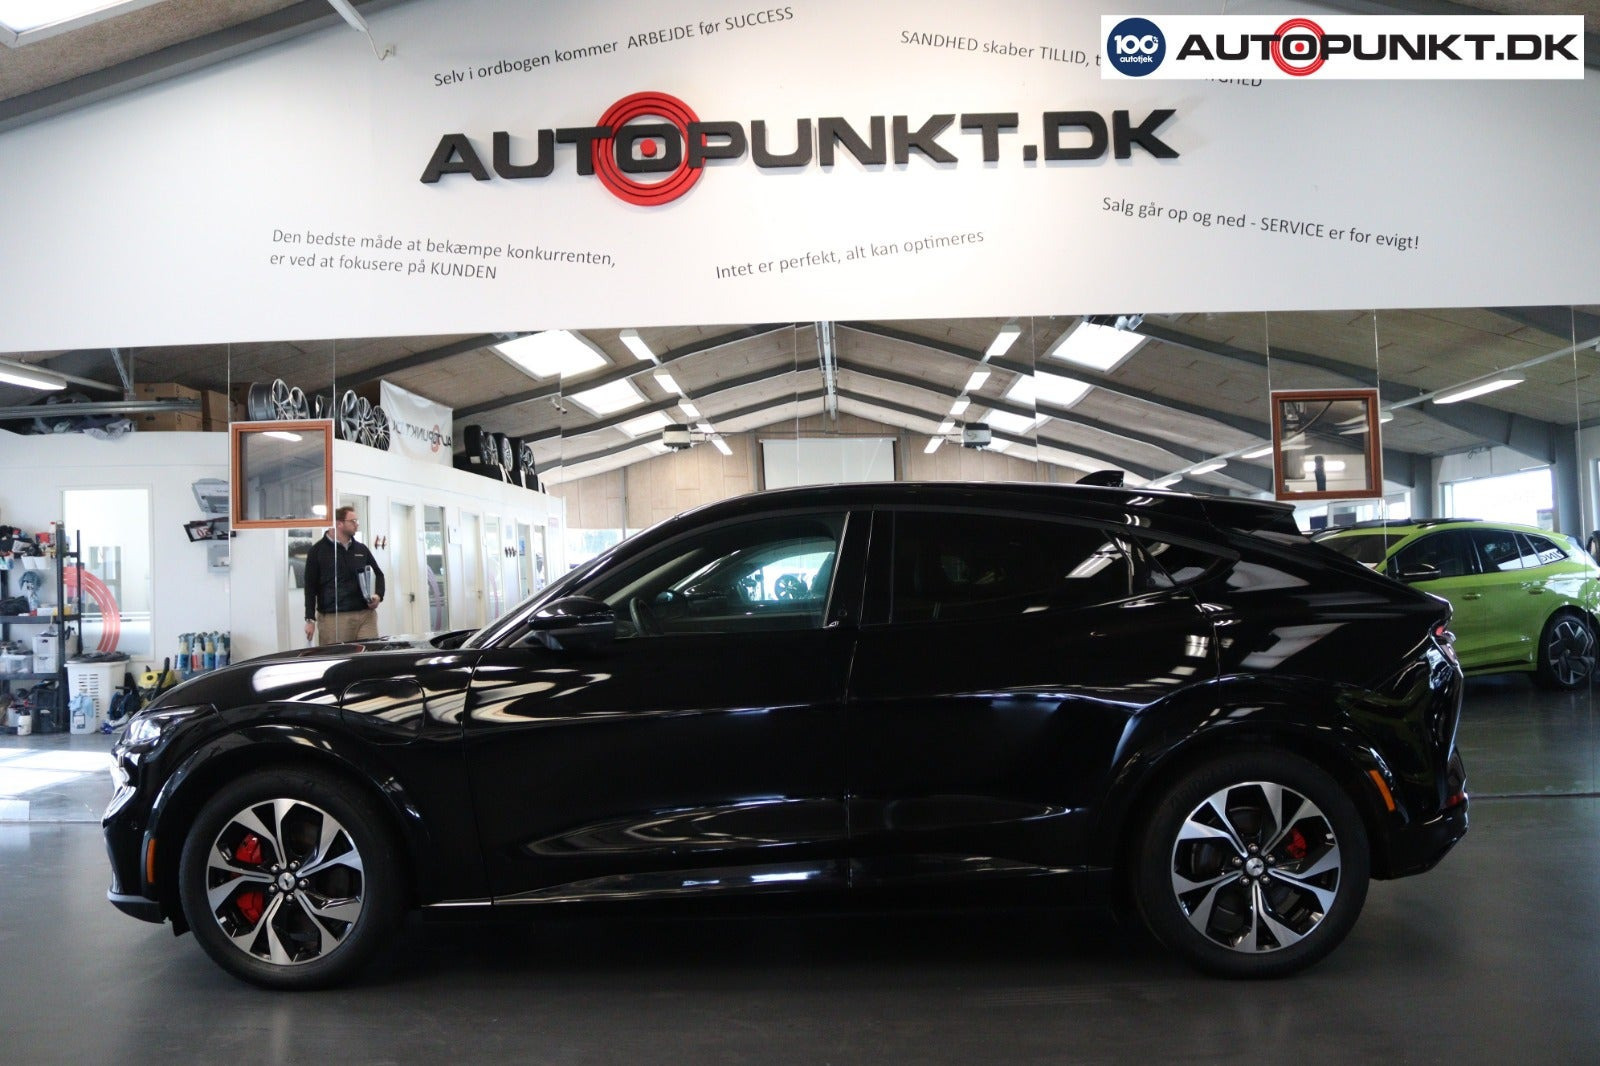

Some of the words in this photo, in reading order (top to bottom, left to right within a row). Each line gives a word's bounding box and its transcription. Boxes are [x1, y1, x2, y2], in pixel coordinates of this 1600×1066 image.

[433, 69, 465, 87] Selv
[468, 66, 474, 80] i
[477, 55, 551, 78] ordbogen
[554, 41, 618, 63] kommer
[627, 24, 695, 49] ARBEJDE
[698, 21, 721, 36] før
[724, 6, 794, 31] SUCCESS
[900, 30, 979, 51] SANDHED
[982, 39, 1035, 58] skaber
[1039, 46, 1090, 68] TILLID,
[419, 108, 1181, 184] AUTOPUNKT.DK
[1102, 196, 1134, 217] Salg
[1137, 201, 1164, 219] går
[1167, 208, 1188, 224] op
[1192, 211, 1212, 227] og
[1216, 213, 1246, 228] ned
[1260, 217, 1324, 238] SERVICE
[1328, 228, 1346, 240] er
[1349, 227, 1372, 244] for
[1375, 234, 1419, 252] evigt!
[269, 254, 286, 265] er
[289, 252, 316, 267] ved
[319, 255, 335, 269] at
[339, 254, 404, 273] fokusere
[407, 258, 426, 276] på
[430, 261, 497, 280] KUNDEN
[272, 229, 302, 244] Den
[306, 230, 356, 248] bedste
[360, 234, 403, 250] måde
[406, 239, 422, 252] at
[426, 238, 502, 260] bekæmpe
[506, 243, 616, 268] konkurrenten,
[716, 262, 753, 279] Intet
[758, 261, 774, 273] er
[779, 250, 841, 274] perfekt,
[846, 245, 866, 261] alt
[870, 243, 899, 257] kan
[903, 231, 984, 253] optimeres
